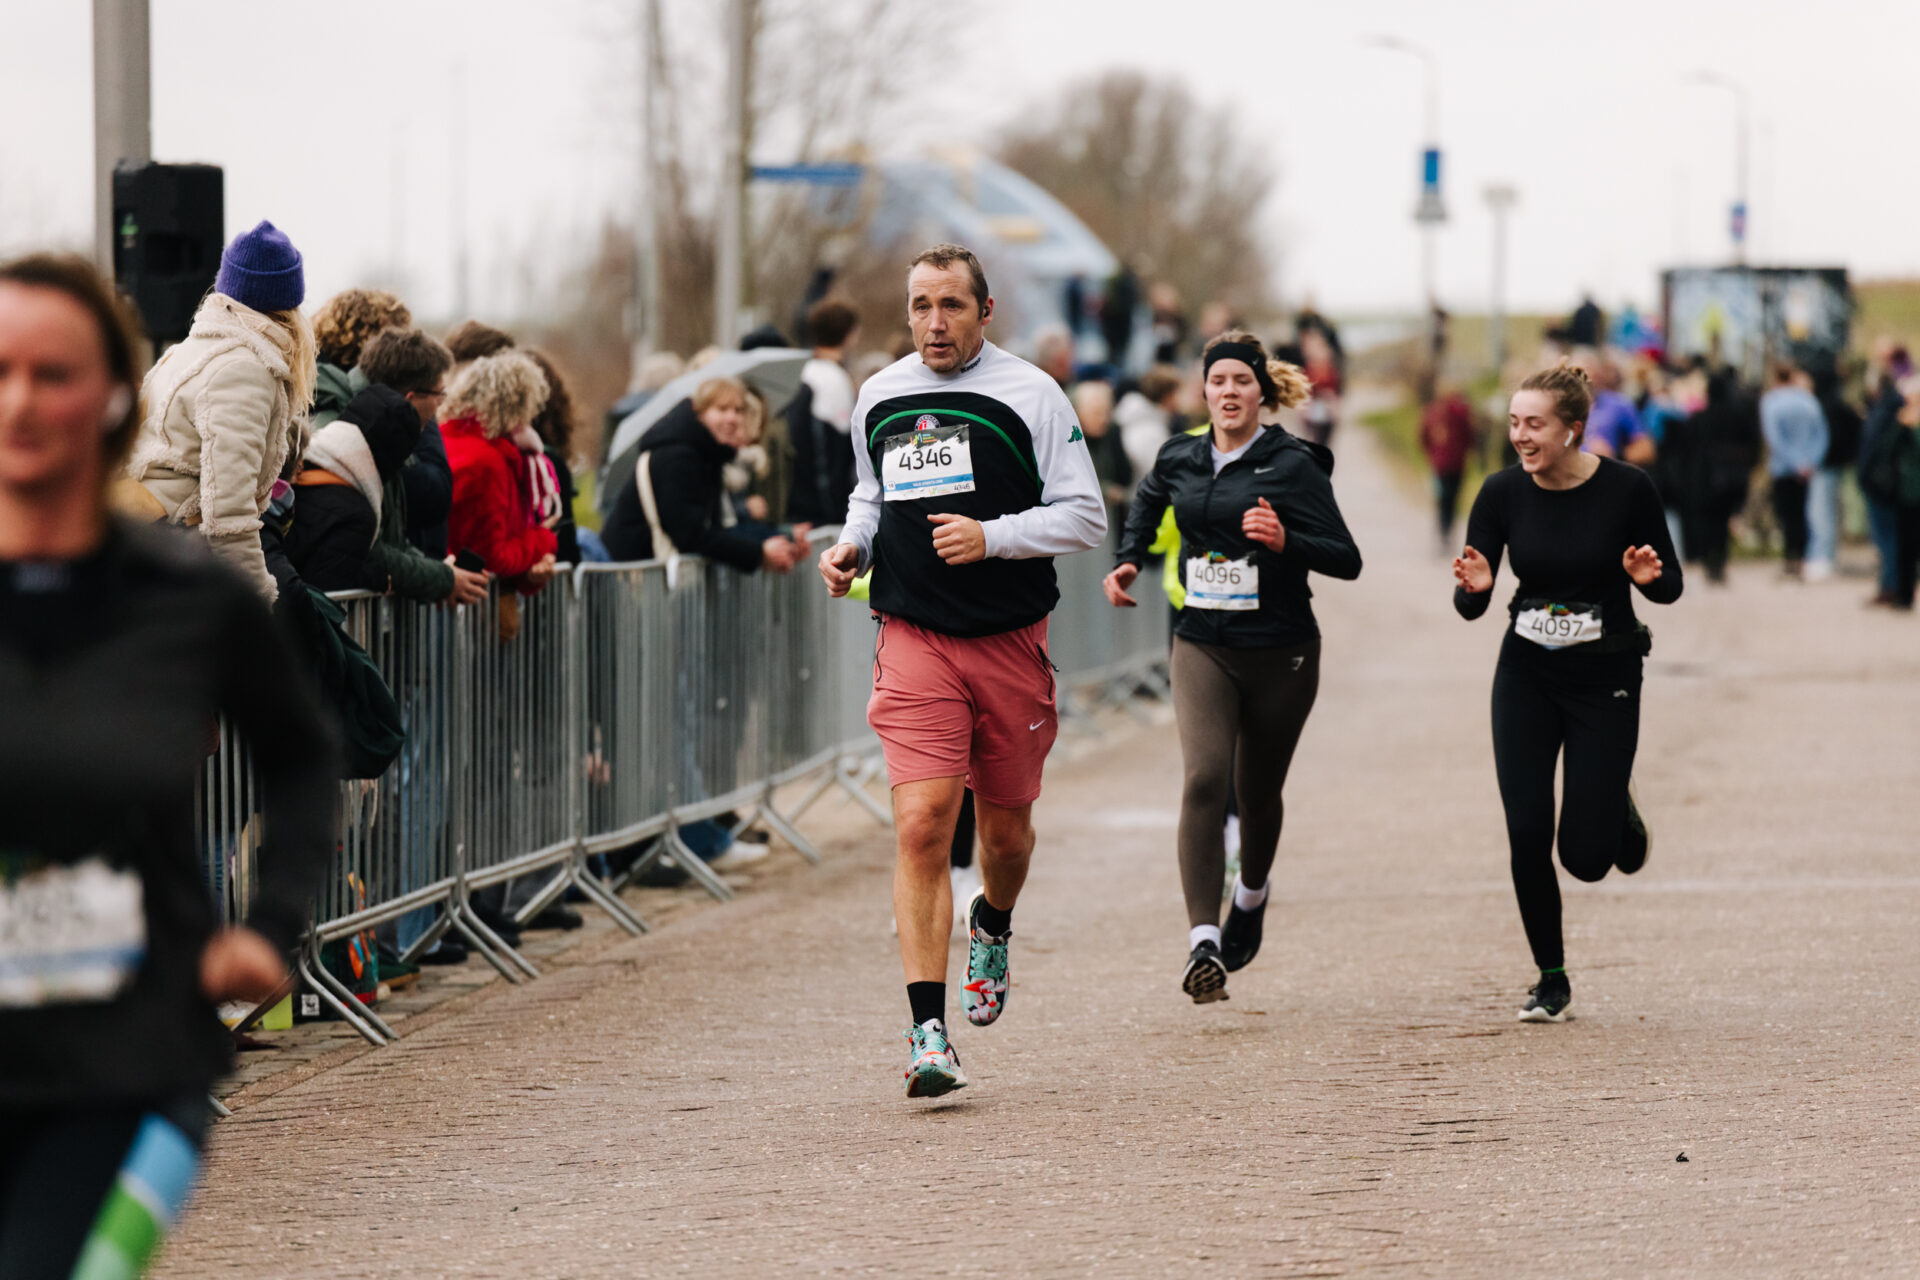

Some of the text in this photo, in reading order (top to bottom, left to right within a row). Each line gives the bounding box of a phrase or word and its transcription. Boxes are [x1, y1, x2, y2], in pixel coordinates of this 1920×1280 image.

[899, 446, 952, 471] 4346
[1195, 565, 1242, 584] 4096
[1531, 617, 1584, 637] 4097
